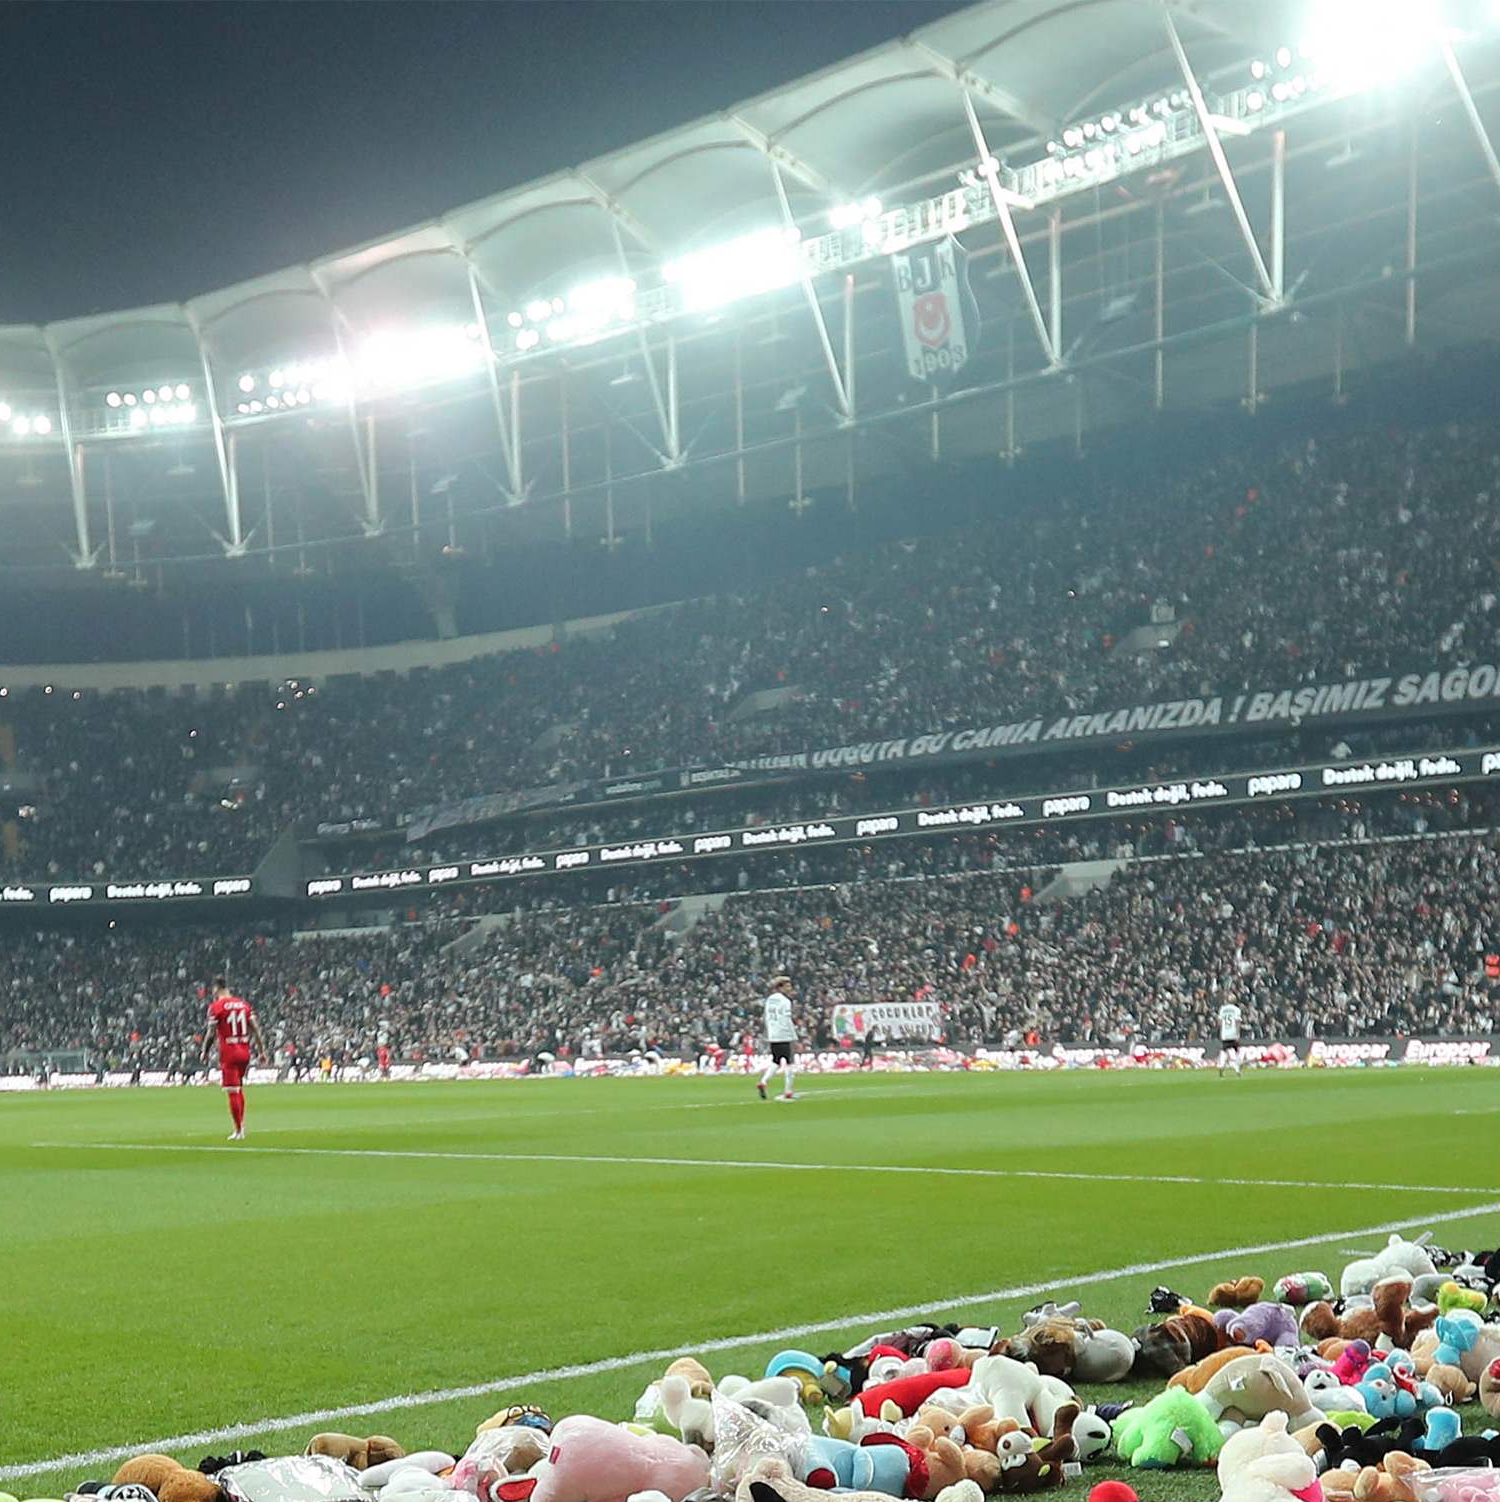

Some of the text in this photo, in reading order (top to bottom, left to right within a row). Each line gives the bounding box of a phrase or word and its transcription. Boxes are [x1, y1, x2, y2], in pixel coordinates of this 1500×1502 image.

[1248, 773, 1302, 797] papara
[1043, 796, 1090, 817] papara
[857, 817, 899, 836] papara
[694, 835, 732, 853] papara
[556, 852, 590, 869] papara
[429, 867, 458, 883] papara
[50, 887, 92, 903] papara
[214, 879, 251, 895] papara
[307, 879, 342, 895] papara
[227, 1009, 247, 1036] 11
[1309, 1039, 1391, 1059] Europcar
[1404, 1037, 1491, 1059] Europcar
